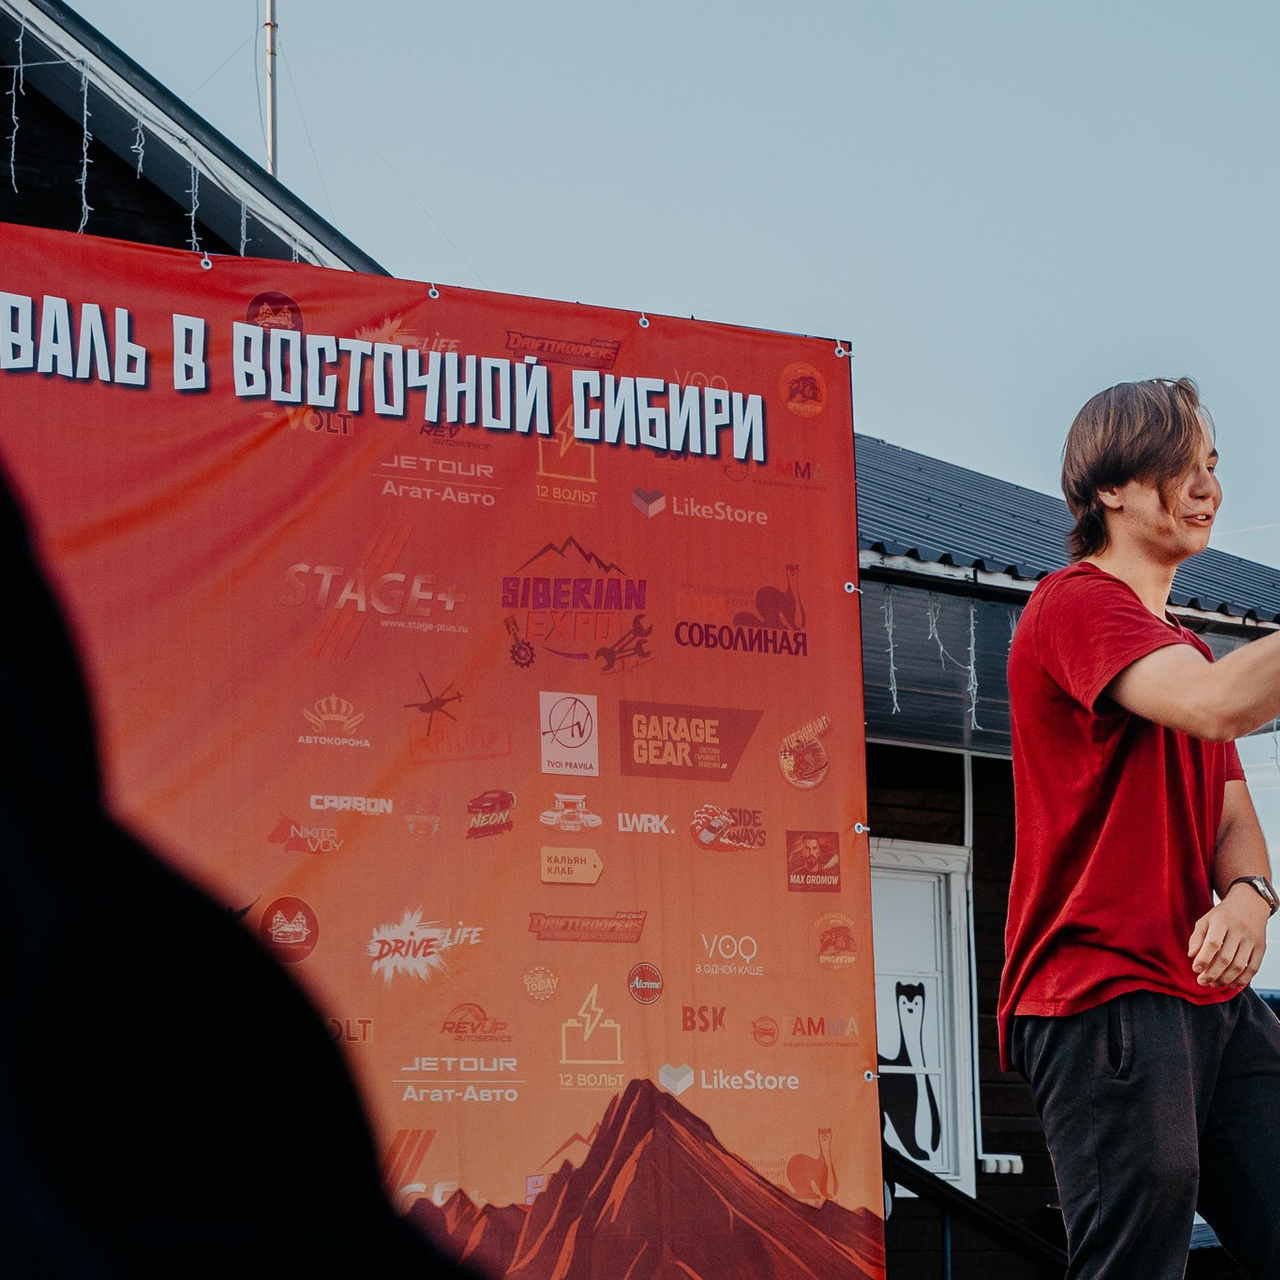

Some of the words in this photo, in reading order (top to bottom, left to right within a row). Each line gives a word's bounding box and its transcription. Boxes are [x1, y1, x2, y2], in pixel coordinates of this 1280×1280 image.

[0, 291, 147, 385] ВАЛЬ
[172, 313, 206, 389] В
[233, 321, 550, 435] ВОСТОЧНОЙ
[572, 369, 765, 461] СИБИРИ
[284, 406, 353, 436] VOLT
[381, 455, 494, 479] JETOUR
[381, 480, 496, 506] Агат-Авто
[536, 484, 549, 497] 12
[552, 486, 599, 504] ВОЛЬТ
[672, 496, 769, 525] LikeStore
[280, 563, 467, 617] STAGE+
[501, 576, 647, 611] SIBERIAN
[381, 619, 469, 634] www.stage-plus.ru
[674, 621, 808, 657] СОБОЛИНАЯ
[632, 714, 720, 744] GARAGE
[298, 735, 371, 748] АВТОКОРОНА
[633, 739, 693, 767] GEAR
[547, 760, 563, 769] TVOI
[565, 761, 594, 771] PRAVILA
[469, 810, 510, 828] NEON
[727, 807, 763, 827] SIDE
[727, 829, 767, 847] WAYS
[547, 856, 587, 866] КАЛЬЯН
[547, 867, 574, 876] КЛАБ
[789, 874, 805, 884] MAX
[806, 875, 840, 886] GROMOW
[373, 931, 440, 961] DRIVE
[441, 920, 484, 949] LIFE
[681, 1005, 727, 1033] BSK
[454, 1034, 513, 1043] AUTOSERVICE
[401, 1057, 518, 1072] JETOUR
[559, 1073, 573, 1086] 12
[577, 1073, 626, 1086] ВОЛЬТ
[701, 1069, 800, 1090] LikeStore
[402, 1085, 519, 1102] Агат-Авто
